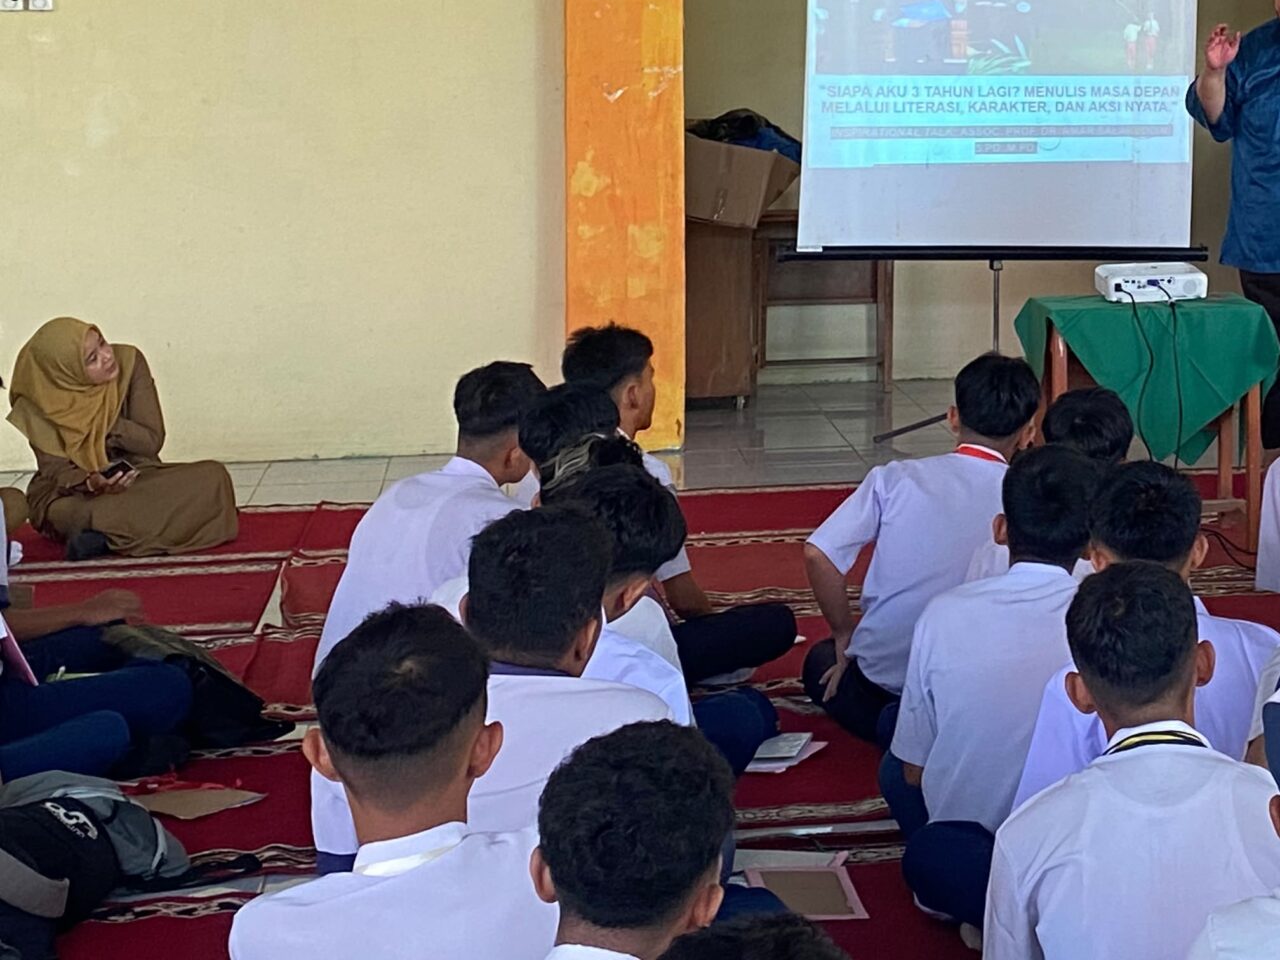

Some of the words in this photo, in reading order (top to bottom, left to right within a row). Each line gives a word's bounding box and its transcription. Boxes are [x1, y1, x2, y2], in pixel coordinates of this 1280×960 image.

[875, 85, 907, 98] AKU
[912, 85, 921, 98] 3
[923, 85, 973, 98] TAHUN
[977, 86, 1020, 98] LAGI?
[1024, 86, 1086, 98] MENULIS
[1090, 86, 1130, 98] MASA
[1133, 85, 1180, 98] DEPAN
[821, 101, 889, 113] MELALUI
[893, 101, 965, 115] LITERASI,
[968, 101, 1051, 115] KARAKTER,
[1055, 101, 1085, 113] DAN
[1088, 101, 1121, 113] AKSI
